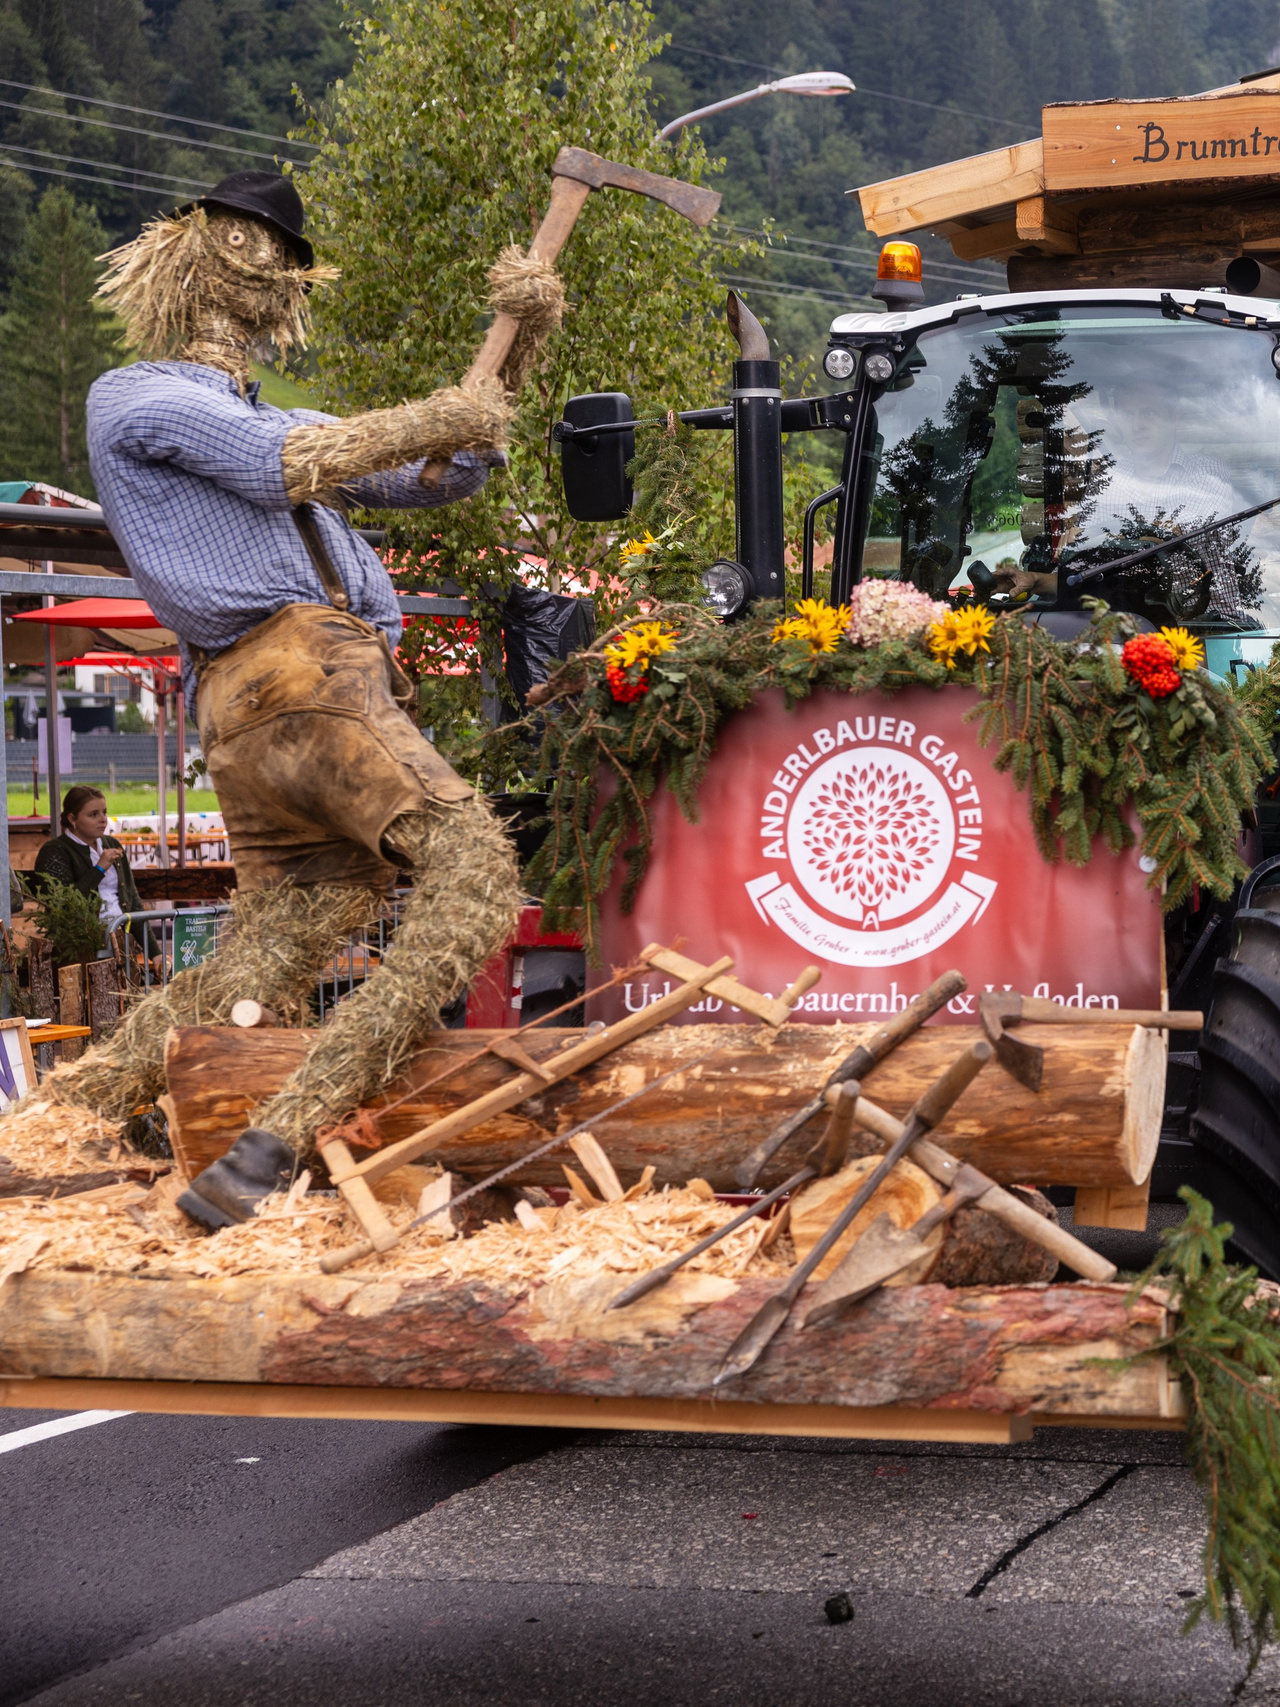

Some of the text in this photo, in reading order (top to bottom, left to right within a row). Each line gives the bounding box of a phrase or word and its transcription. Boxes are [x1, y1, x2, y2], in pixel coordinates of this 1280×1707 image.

[760, 715, 983, 862] ANDERLBAUER GASTEIN
[774, 897, 812, 935] Familie
[814, 934, 850, 953] Gruber
